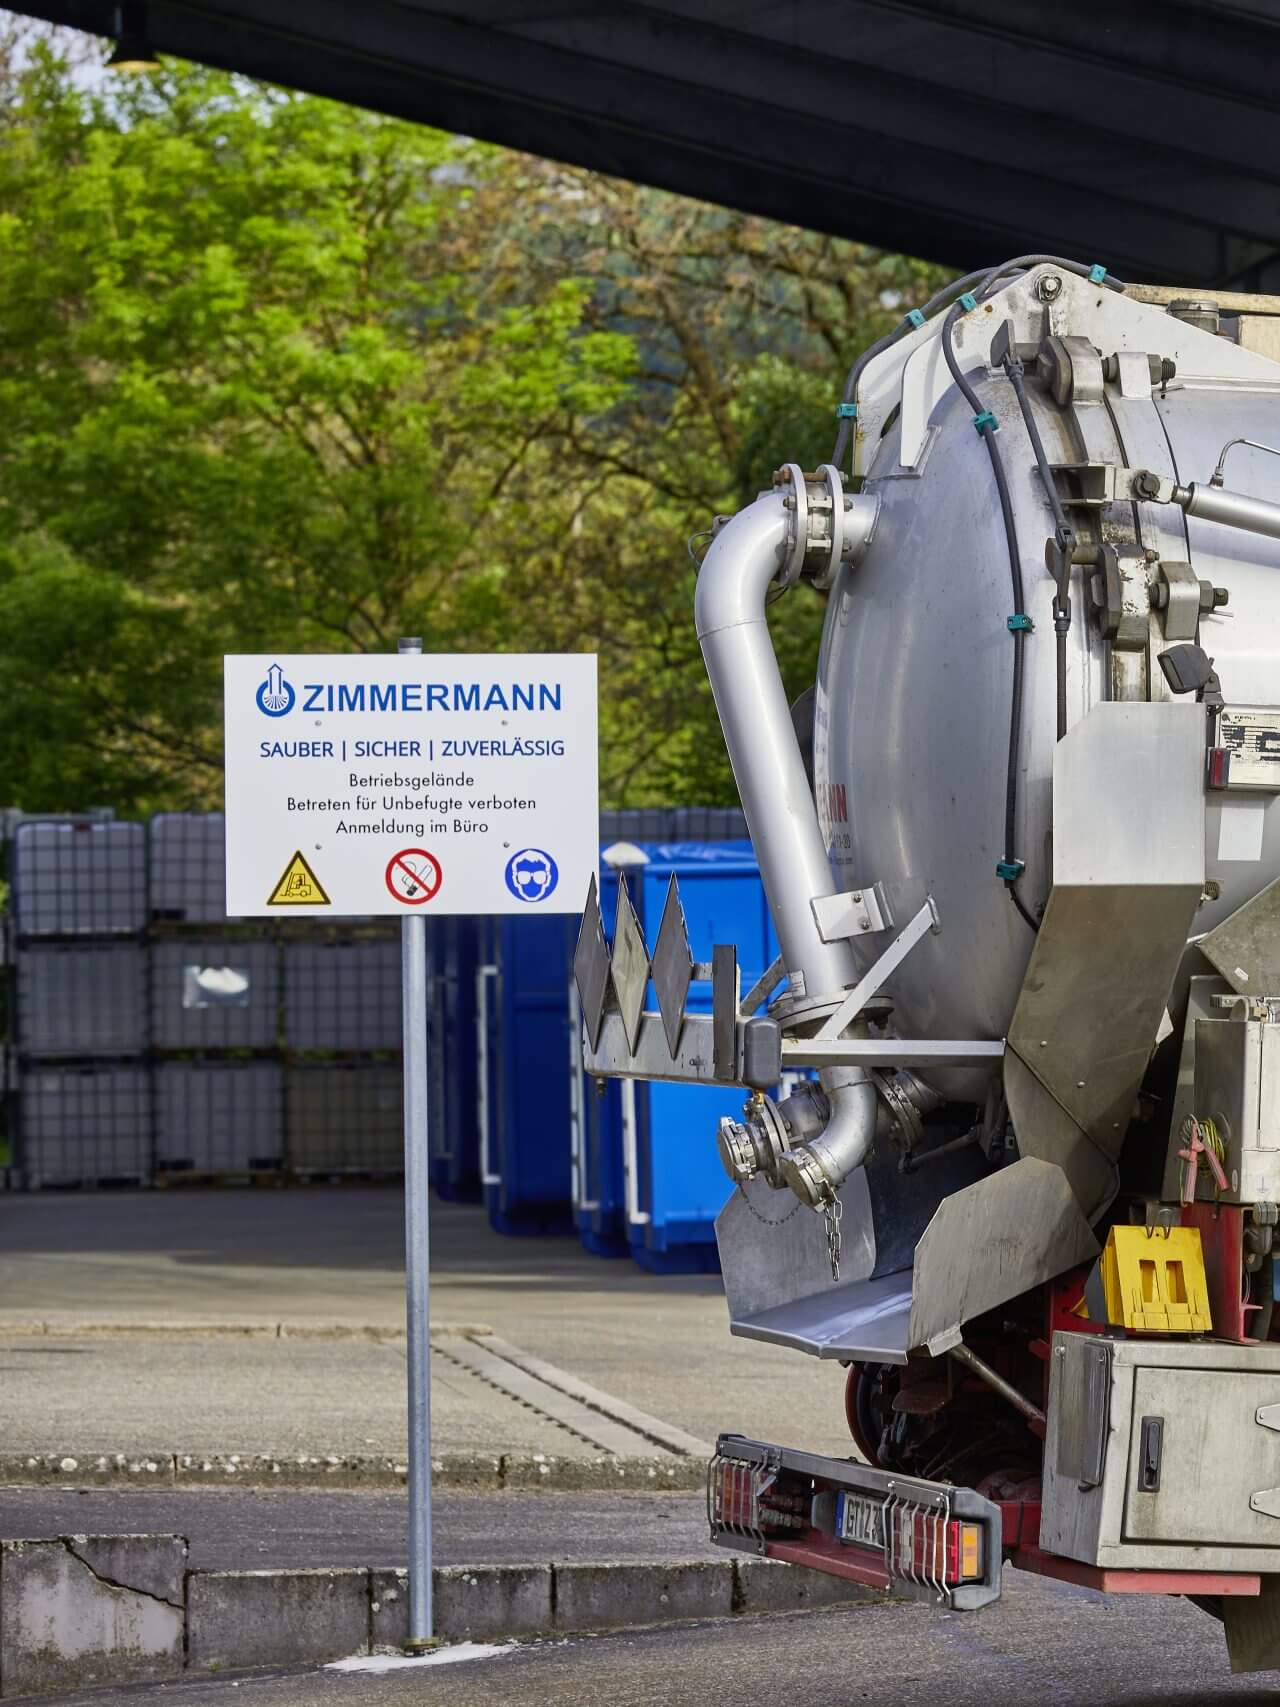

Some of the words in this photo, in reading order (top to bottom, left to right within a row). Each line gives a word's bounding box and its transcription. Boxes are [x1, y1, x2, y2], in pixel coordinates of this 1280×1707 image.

[302, 683, 562, 712] ZIMMERMANN
[260, 741, 334, 758] SAUBER
[354, 740, 421, 758] SICHER
[441, 737, 565, 757] ZUVERLÄSSIG
[349, 772, 475, 791] Betriebsgelände
[287, 797, 351, 811] Betreten
[356, 796, 377, 811] für
[382, 795, 463, 814] Unbefugte
[468, 795, 536, 810] verboten
[335, 818, 425, 837] Anmeldung
[430, 820, 447, 833] im
[453, 818, 489, 833] Büro
